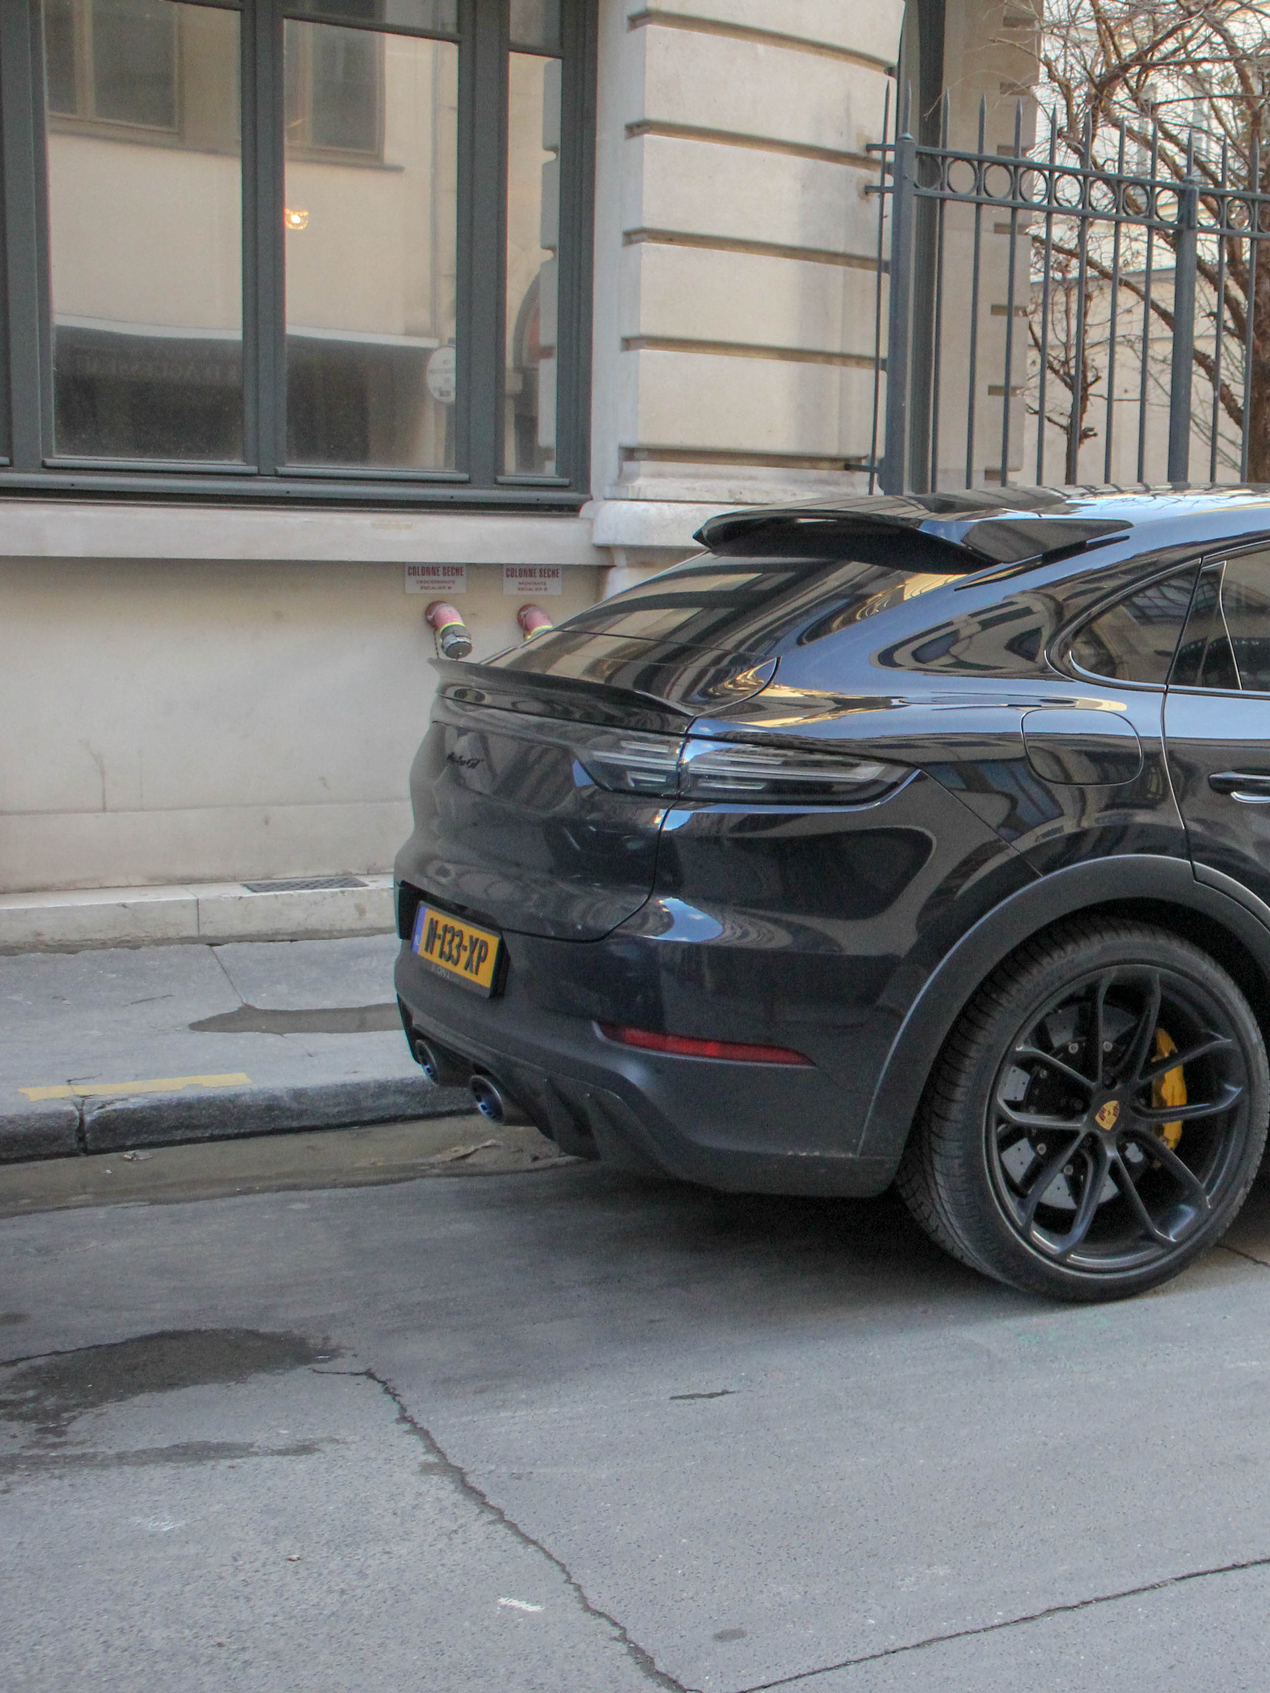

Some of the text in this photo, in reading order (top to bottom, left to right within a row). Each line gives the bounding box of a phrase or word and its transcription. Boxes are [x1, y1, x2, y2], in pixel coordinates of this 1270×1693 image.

[407, 566, 464, 577] COLONNE SECHE
[505, 568, 560, 579] COLONNE SECHE
[424, 917, 489, 976] N-133-XP
